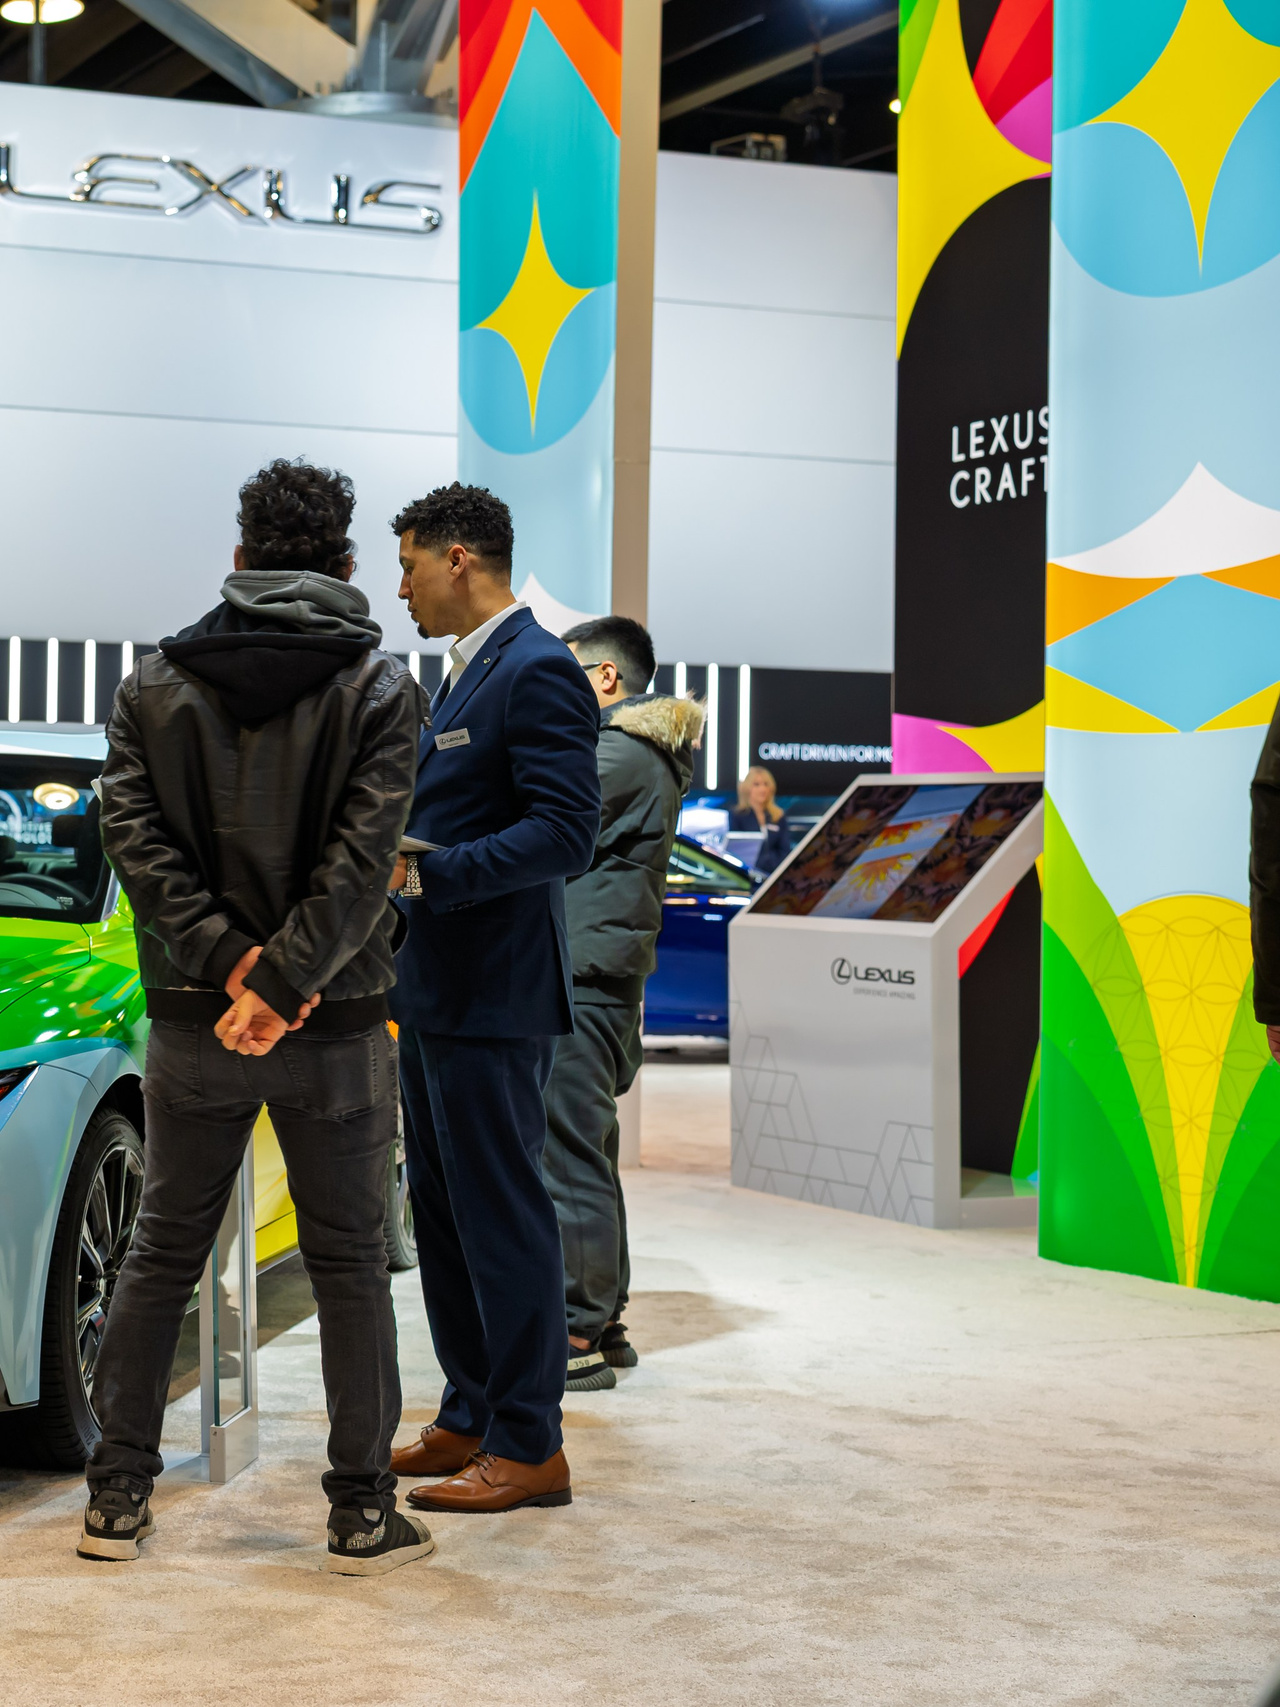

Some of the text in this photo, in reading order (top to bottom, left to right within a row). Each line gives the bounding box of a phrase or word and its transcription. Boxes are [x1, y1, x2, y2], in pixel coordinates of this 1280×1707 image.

[758, 742, 800, 760] CRAFT
[801, 743, 849, 762] DRIVEN
[848, 744, 874, 763] FOR
[853, 966, 915, 985] LEXUS
